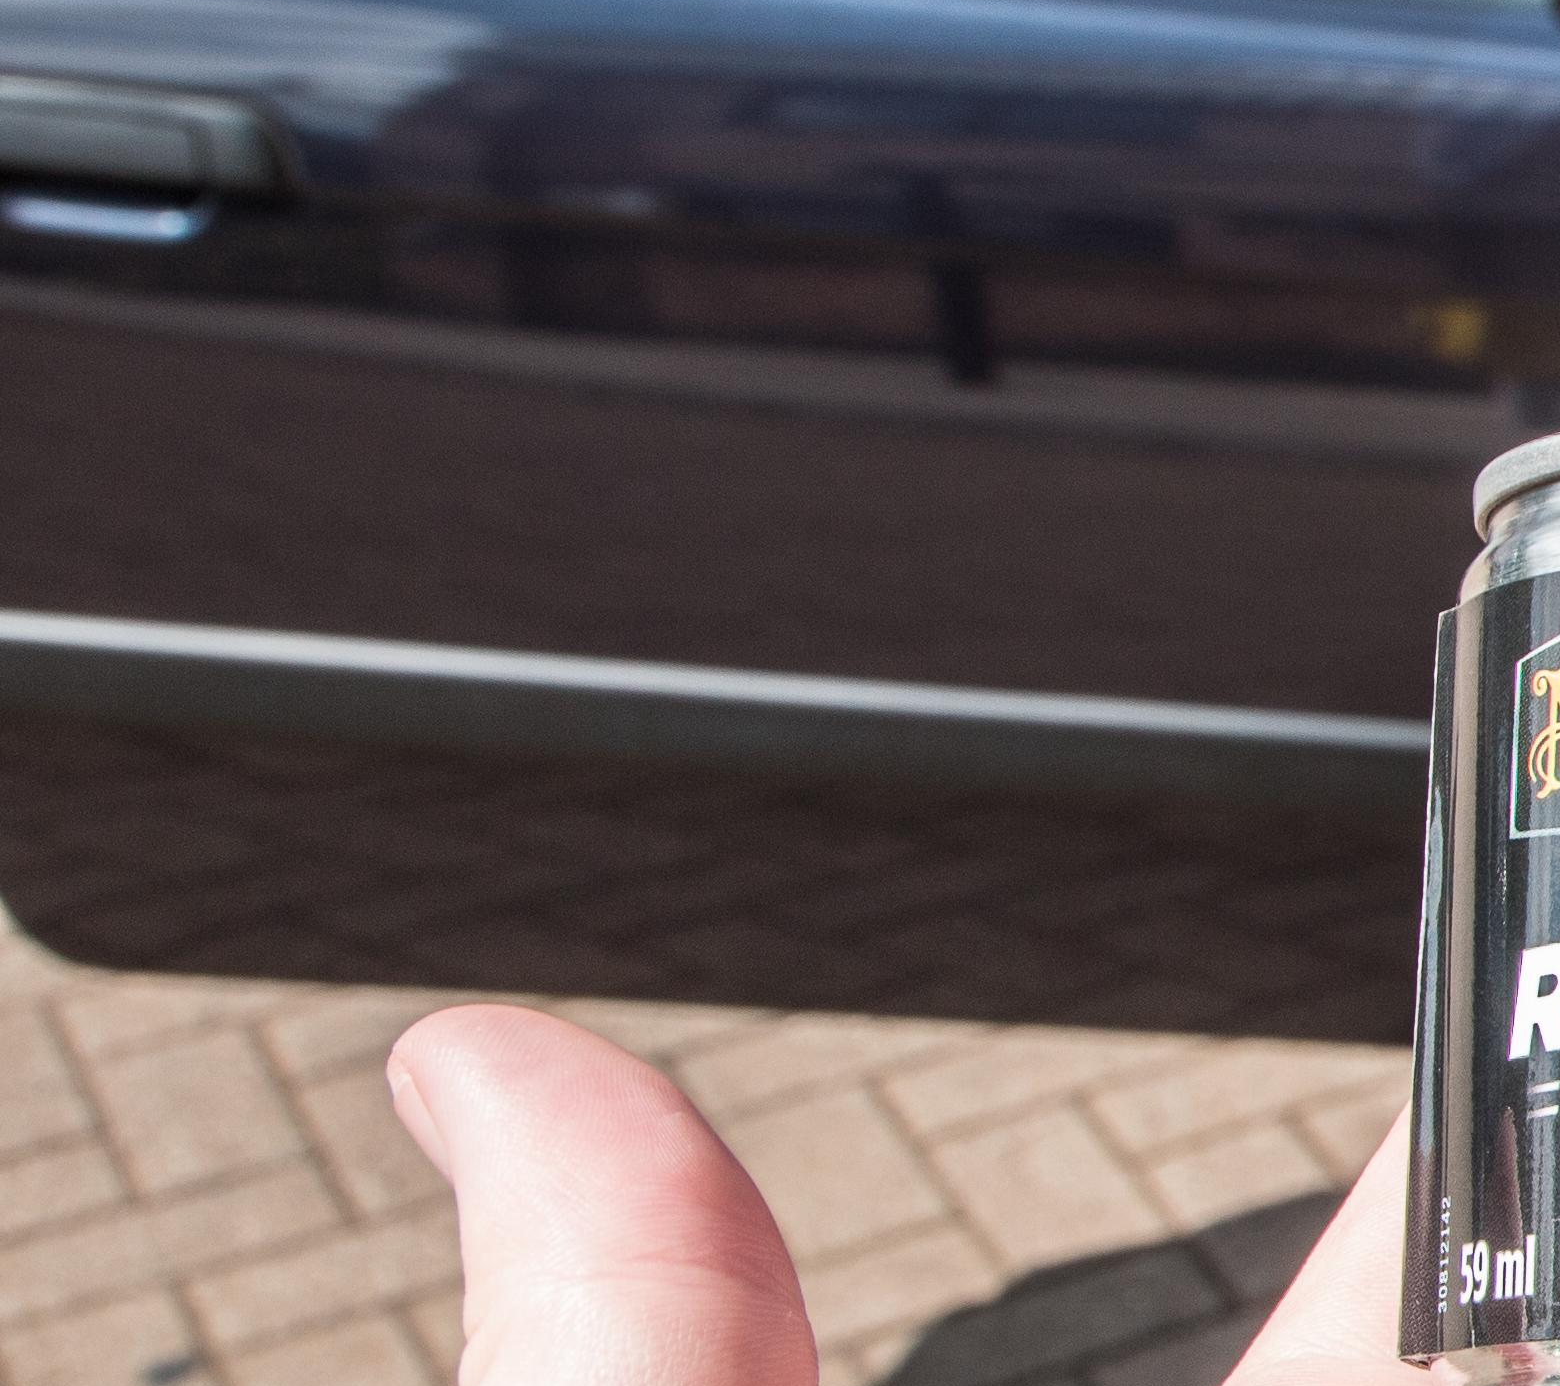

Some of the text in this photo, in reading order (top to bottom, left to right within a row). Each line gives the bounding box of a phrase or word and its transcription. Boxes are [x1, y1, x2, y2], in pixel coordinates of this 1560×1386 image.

[1438, 1196, 1451, 1314] 30812142
[1459, 1239, 1489, 1306] 59
[1493, 1233, 1537, 1301] ml
